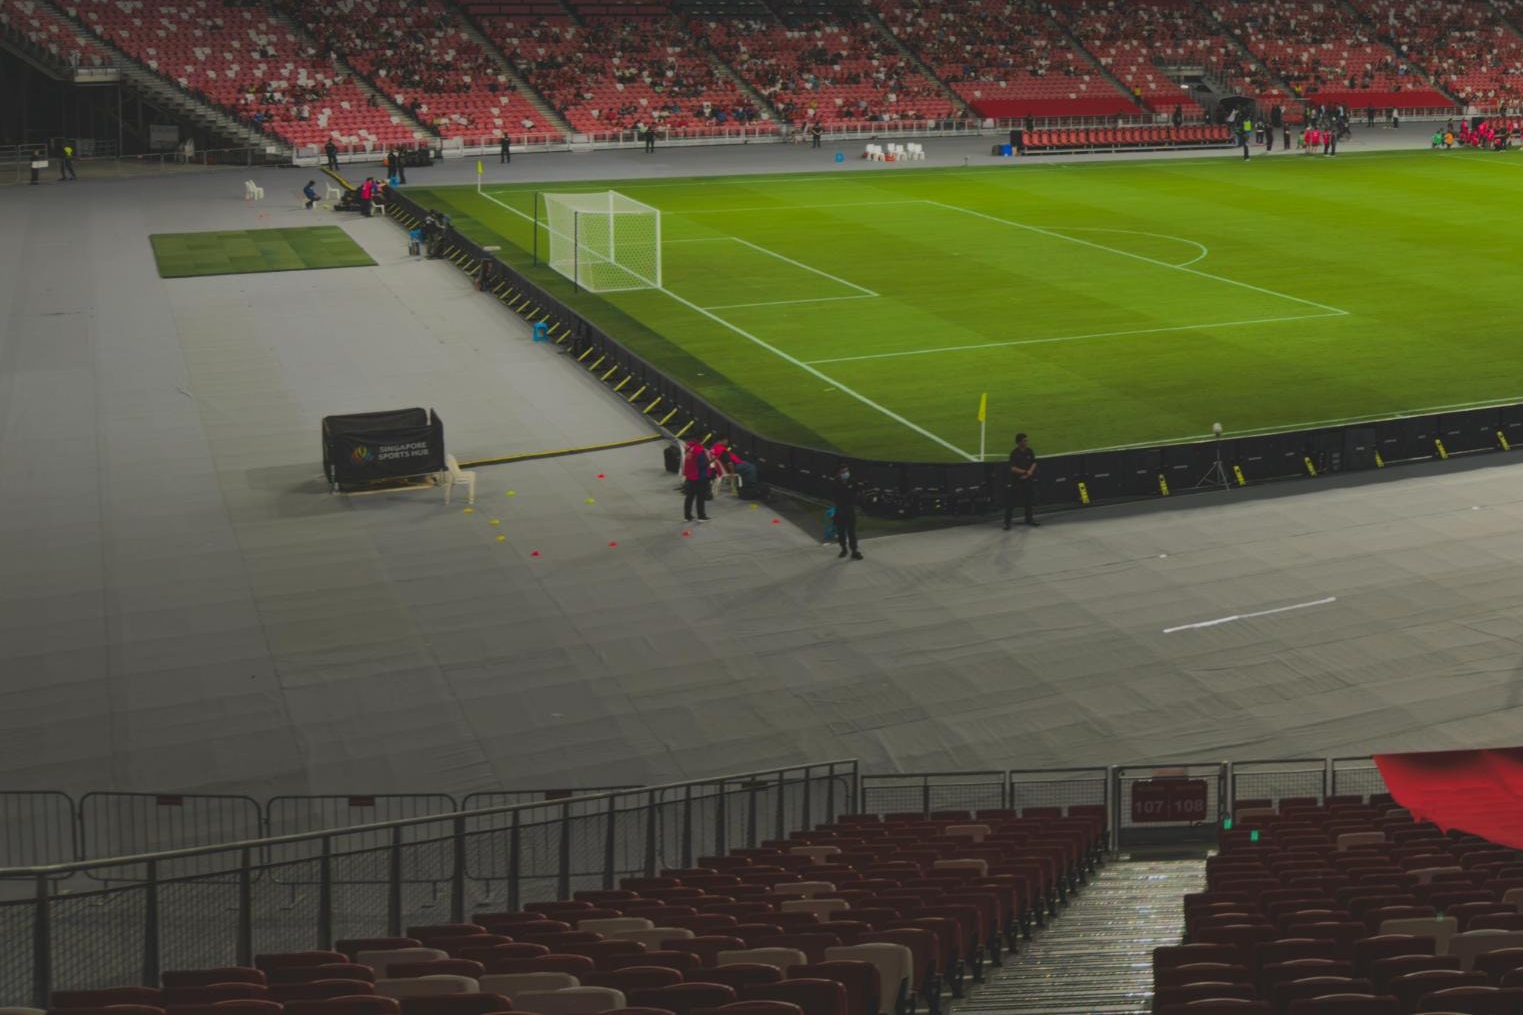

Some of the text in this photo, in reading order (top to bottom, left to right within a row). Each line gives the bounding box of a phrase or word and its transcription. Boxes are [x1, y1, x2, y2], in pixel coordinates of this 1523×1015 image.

[379, 441, 427, 453] SINGAPORE
[378, 448, 429, 461] SPORTS HUB
[1135, 798, 1204, 814] 107 108
